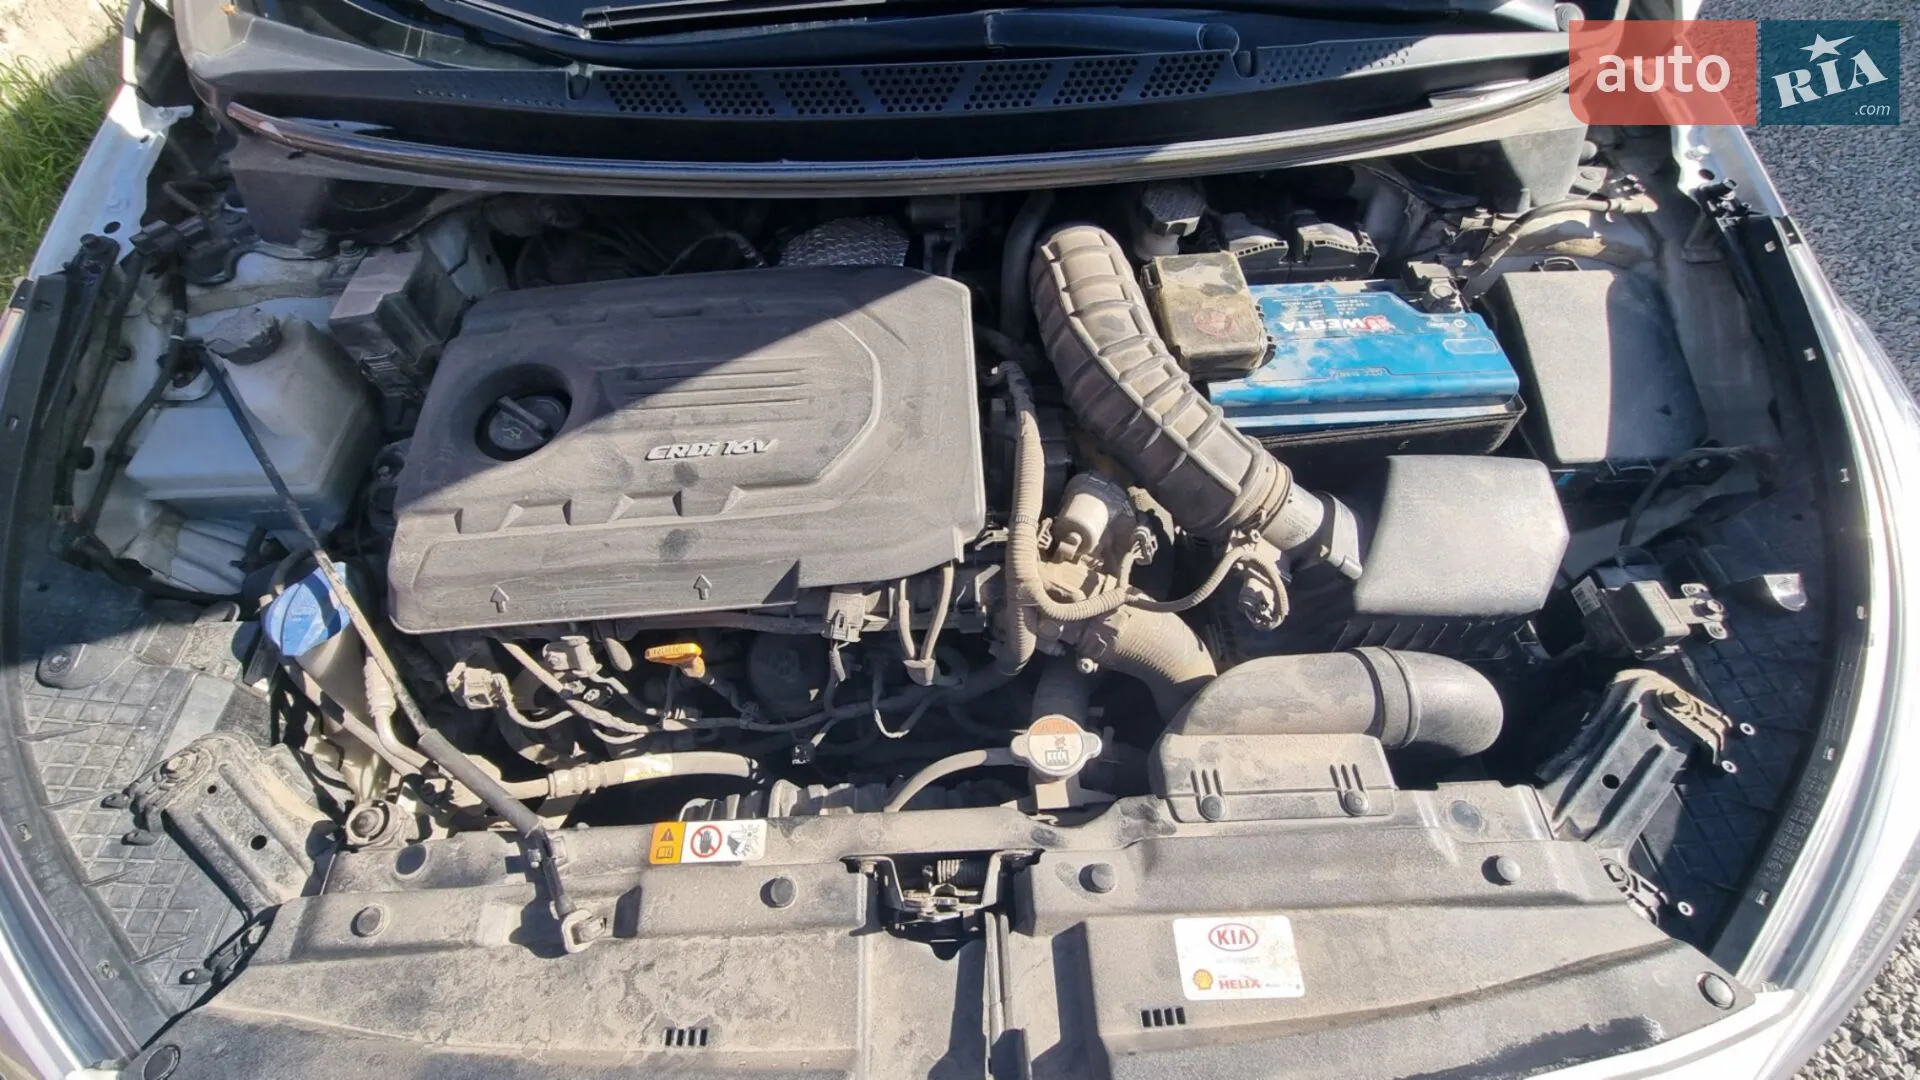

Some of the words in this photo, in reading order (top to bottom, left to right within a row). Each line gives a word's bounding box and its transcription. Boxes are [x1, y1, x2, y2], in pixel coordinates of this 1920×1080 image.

[1280, 317, 1366, 333] WESTA
[644, 442, 719, 461] CRDi
[721, 438, 778, 456] 16V
[1216, 929, 1251, 946] KIA
[1218, 977, 1262, 991] HELIX
